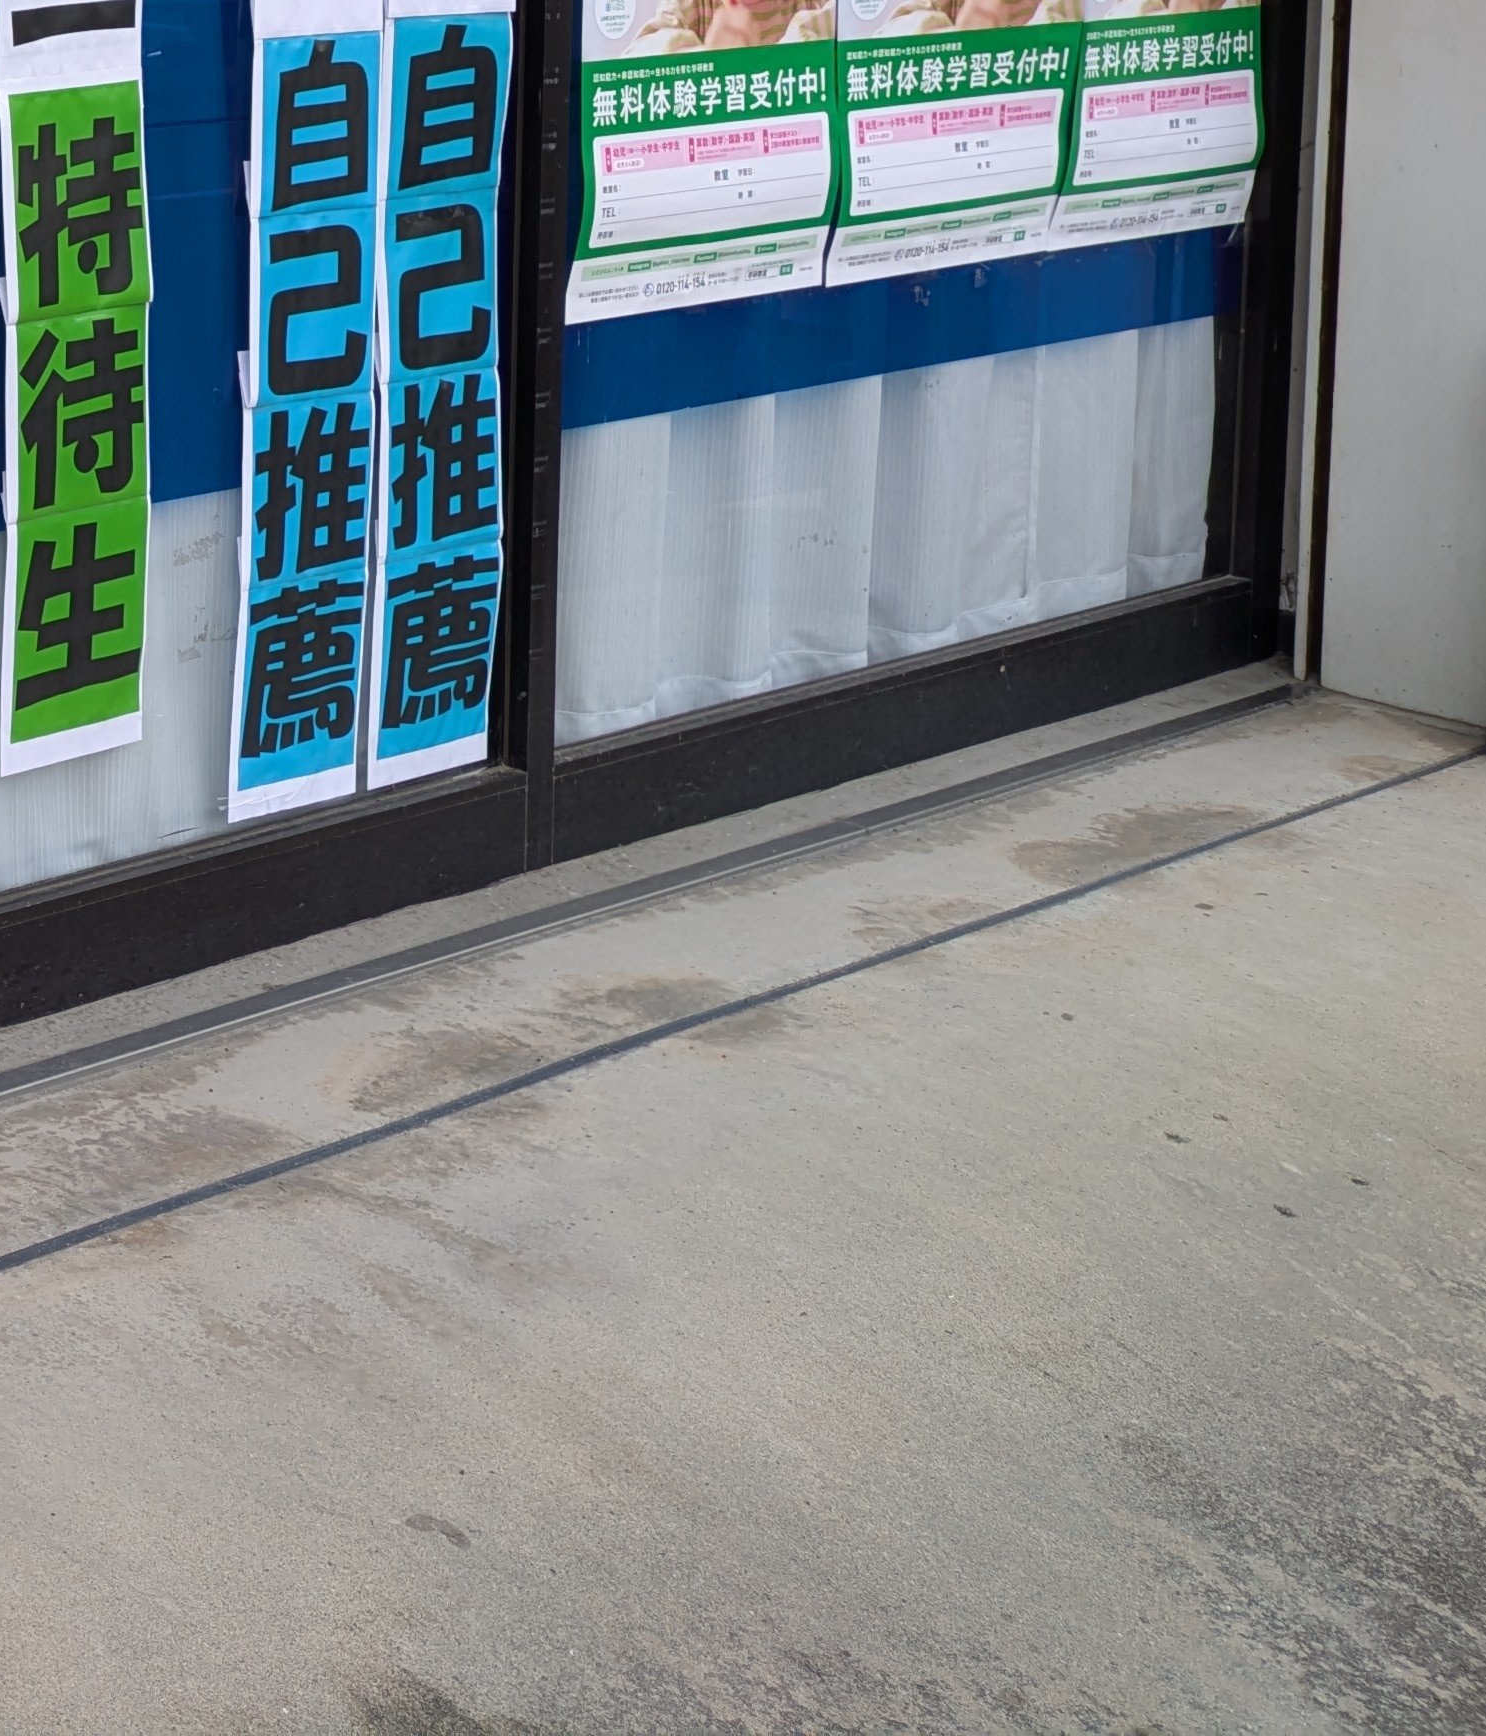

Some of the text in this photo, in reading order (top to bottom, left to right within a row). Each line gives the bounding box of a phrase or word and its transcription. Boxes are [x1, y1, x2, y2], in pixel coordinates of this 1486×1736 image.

[593, 66, 826, 128] 無料体験学習受付中!
